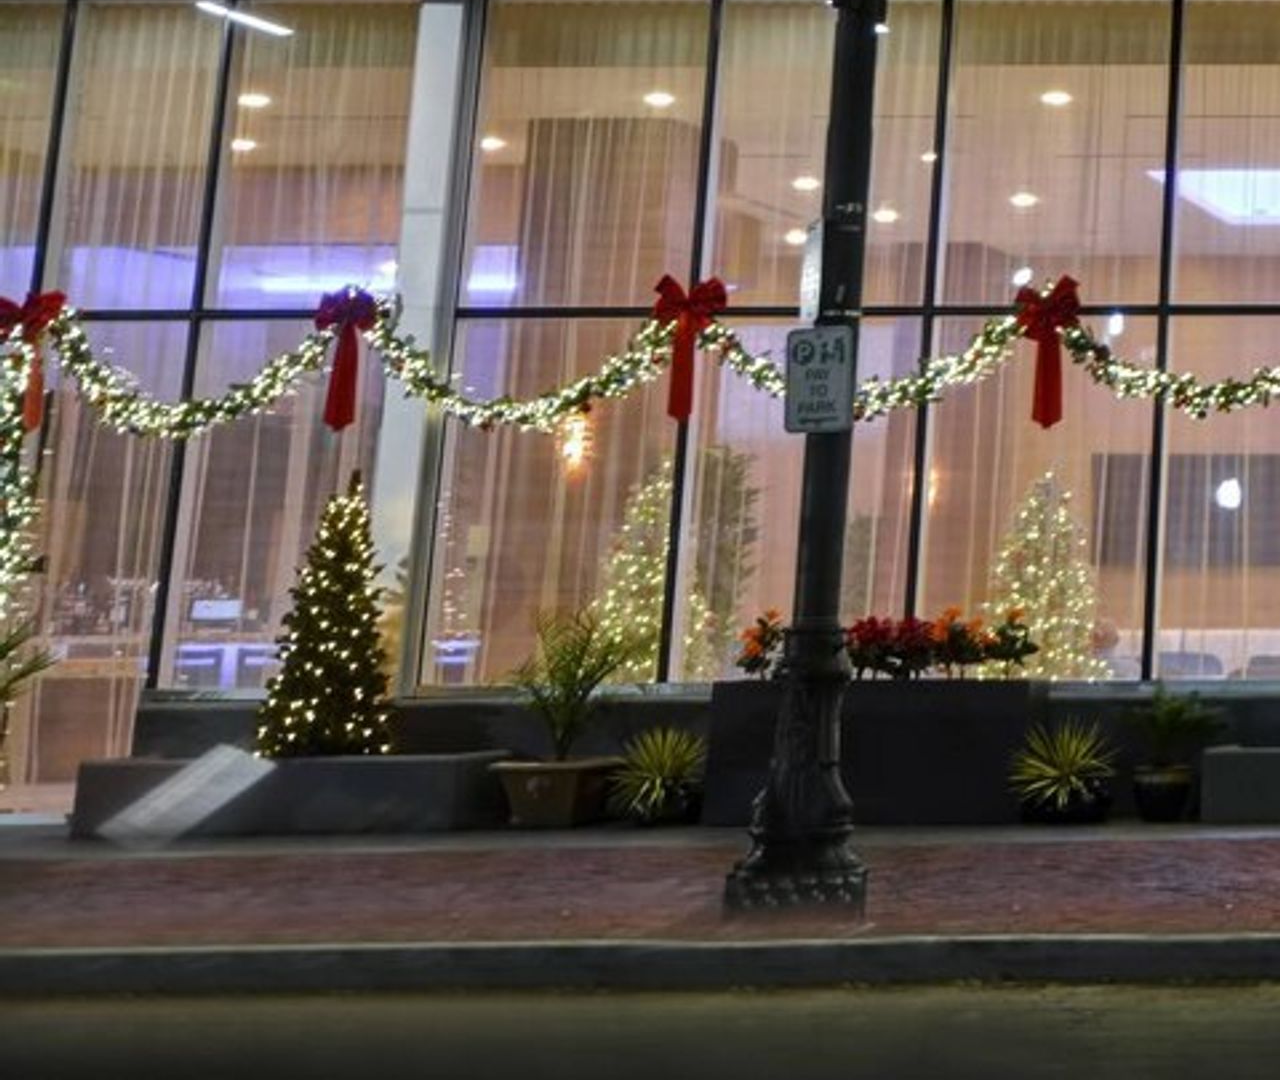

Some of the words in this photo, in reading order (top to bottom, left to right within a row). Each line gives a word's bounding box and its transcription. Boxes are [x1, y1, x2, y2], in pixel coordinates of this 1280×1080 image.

[805, 368, 831, 380] PAY
[809, 384, 828, 397] TO
[797, 399, 837, 414] PARK
